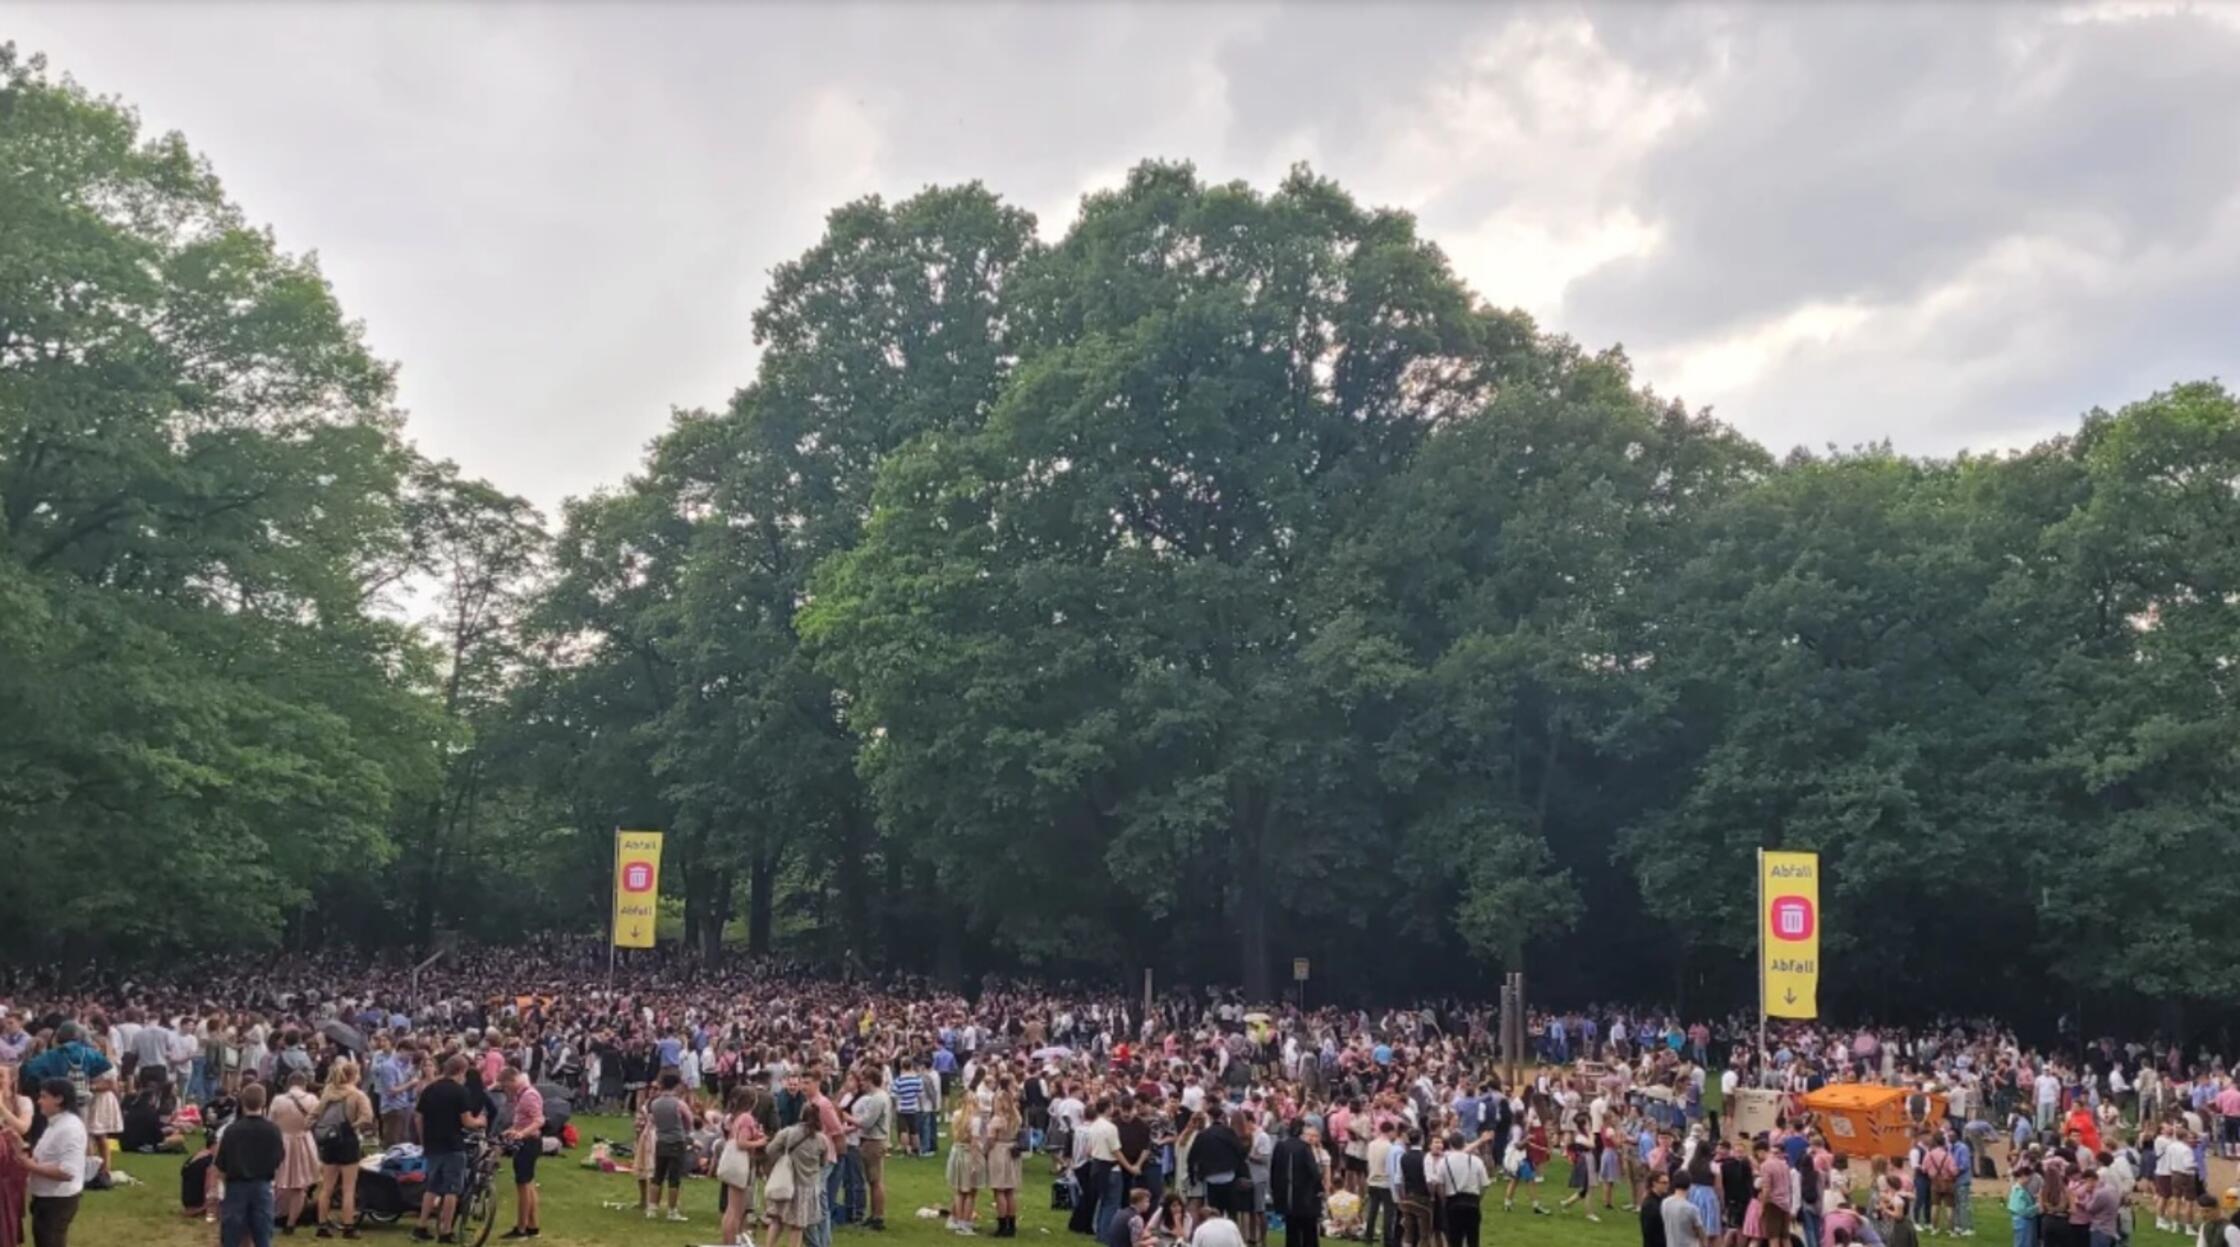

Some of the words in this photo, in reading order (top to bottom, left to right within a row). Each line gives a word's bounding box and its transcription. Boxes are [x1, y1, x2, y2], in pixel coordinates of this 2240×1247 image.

[624, 840, 656, 850] Abfall
[1771, 865, 1812, 878] Abfall
[620, 905, 652, 916] Abfall
[1771, 959, 1814, 974] Abfall
